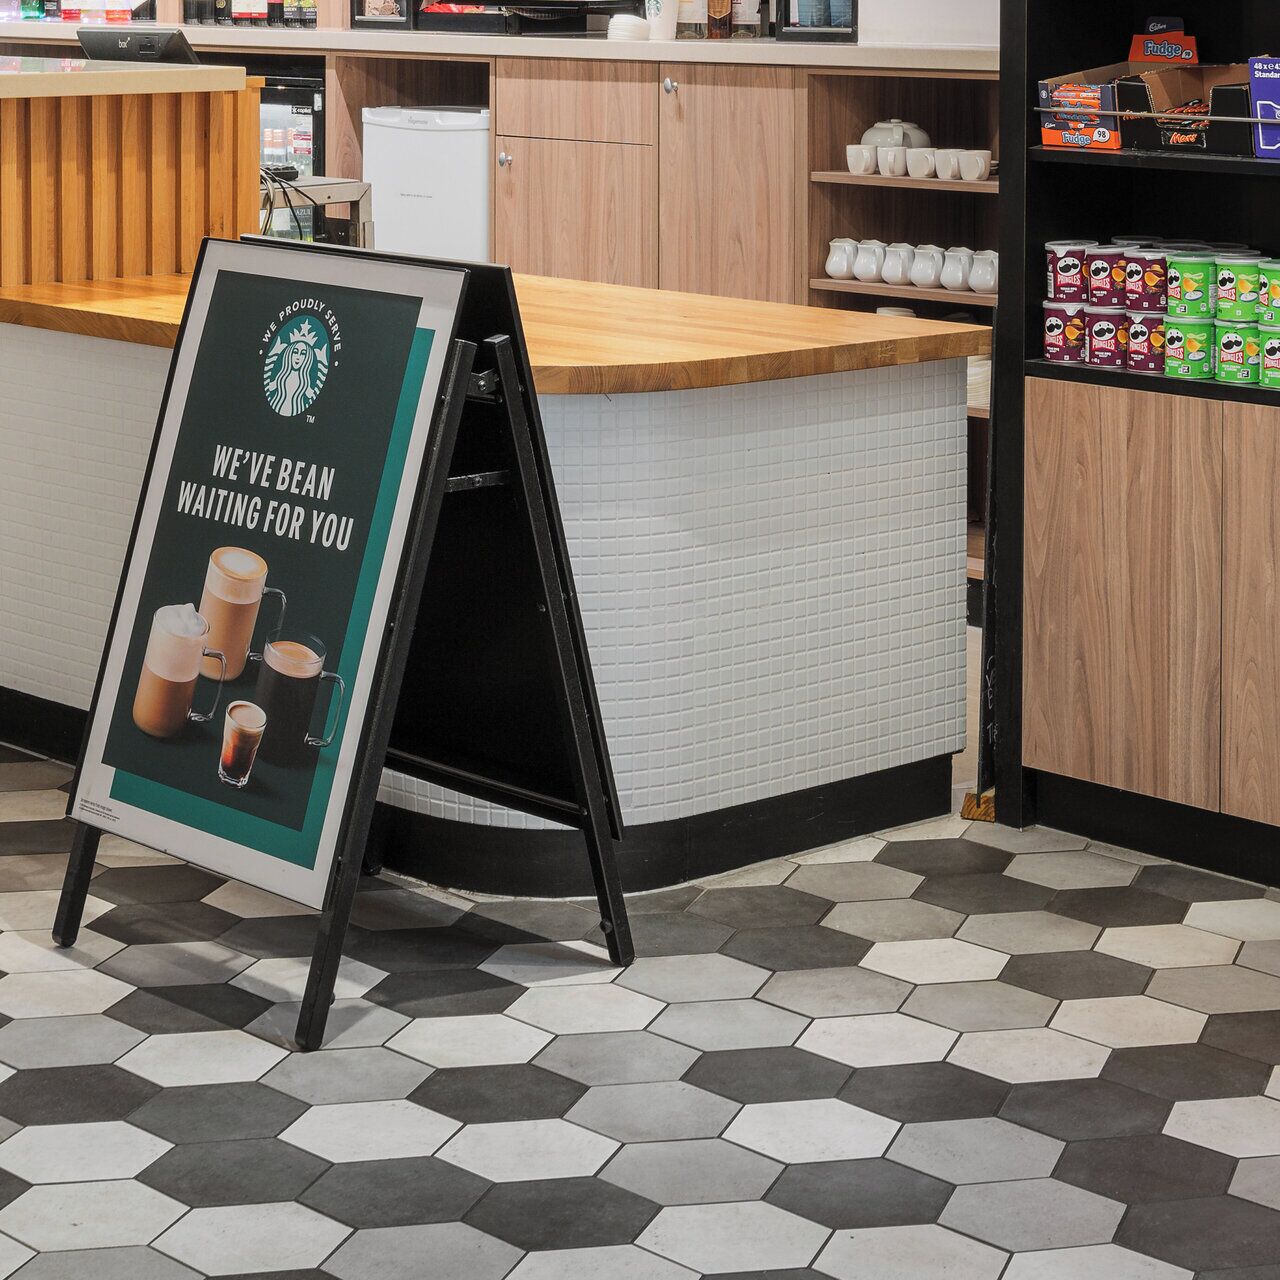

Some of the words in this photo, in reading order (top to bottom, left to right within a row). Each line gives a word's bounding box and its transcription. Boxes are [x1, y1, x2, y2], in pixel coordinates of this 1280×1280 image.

[1144, 40, 1182, 58] Fudge
[1062, 131, 1091, 147] Fudge
[1097, 130, 1106, 138] 98
[1170, 132, 1197, 144] Mars
[1058, 274, 1080, 285] PRINGLES
[263, 322, 277, 343] WE
[279, 299, 326, 321] PROUDLY
[325, 309, 341, 352] SERVE
[1092, 339, 1115, 350] PRINGLES
[1221, 351, 1243, 364] PRINGLES
[306, 414, 316, 424] TM
[212, 444, 276, 488] WE’VE
[276, 458, 336, 501] BEAN
[177, 480, 262, 530] WAITING
[263, 500, 305, 541] FOR
[310, 509, 354, 551] YOU
